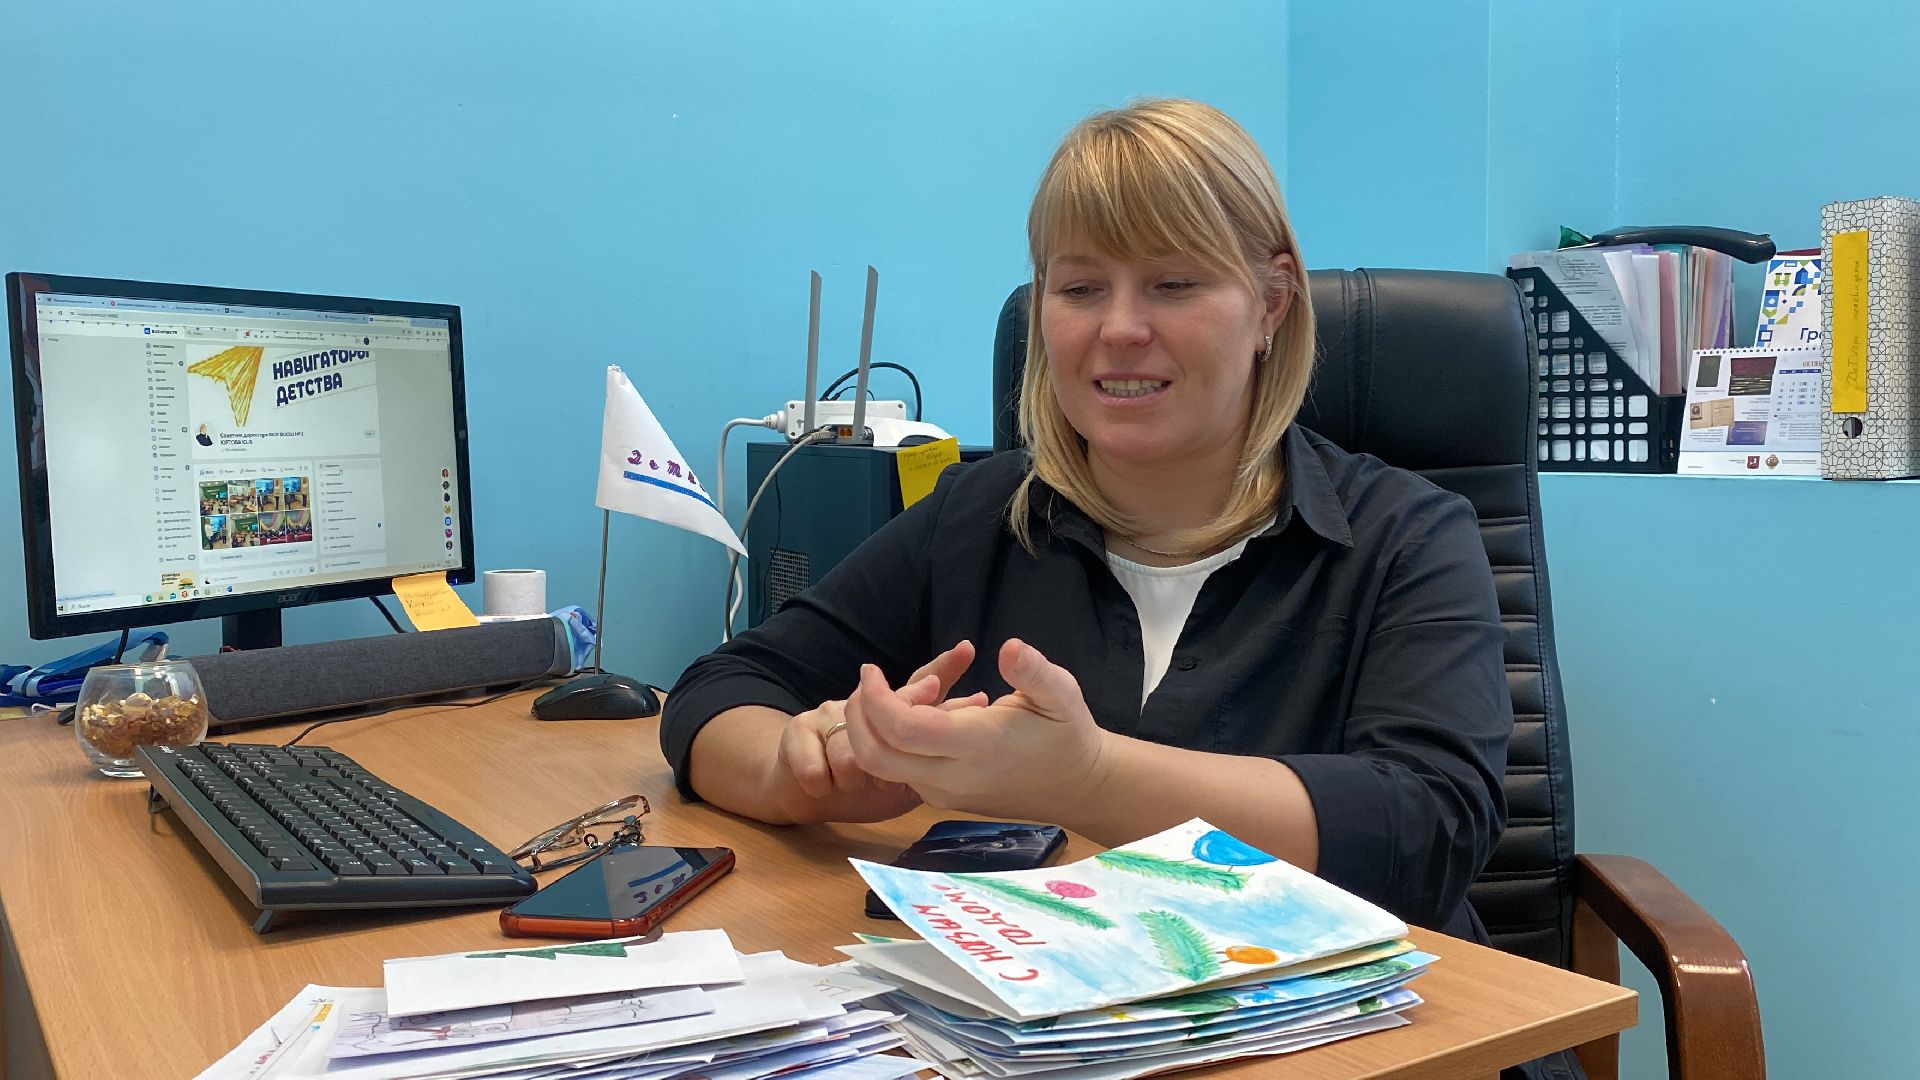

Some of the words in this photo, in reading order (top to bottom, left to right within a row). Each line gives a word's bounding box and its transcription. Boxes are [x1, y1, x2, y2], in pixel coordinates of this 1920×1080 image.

[1800, 327, 1821, 343] Гр
[276, 372, 343, 407] ДЕТСТВА
[277, 593, 299, 603] acer
